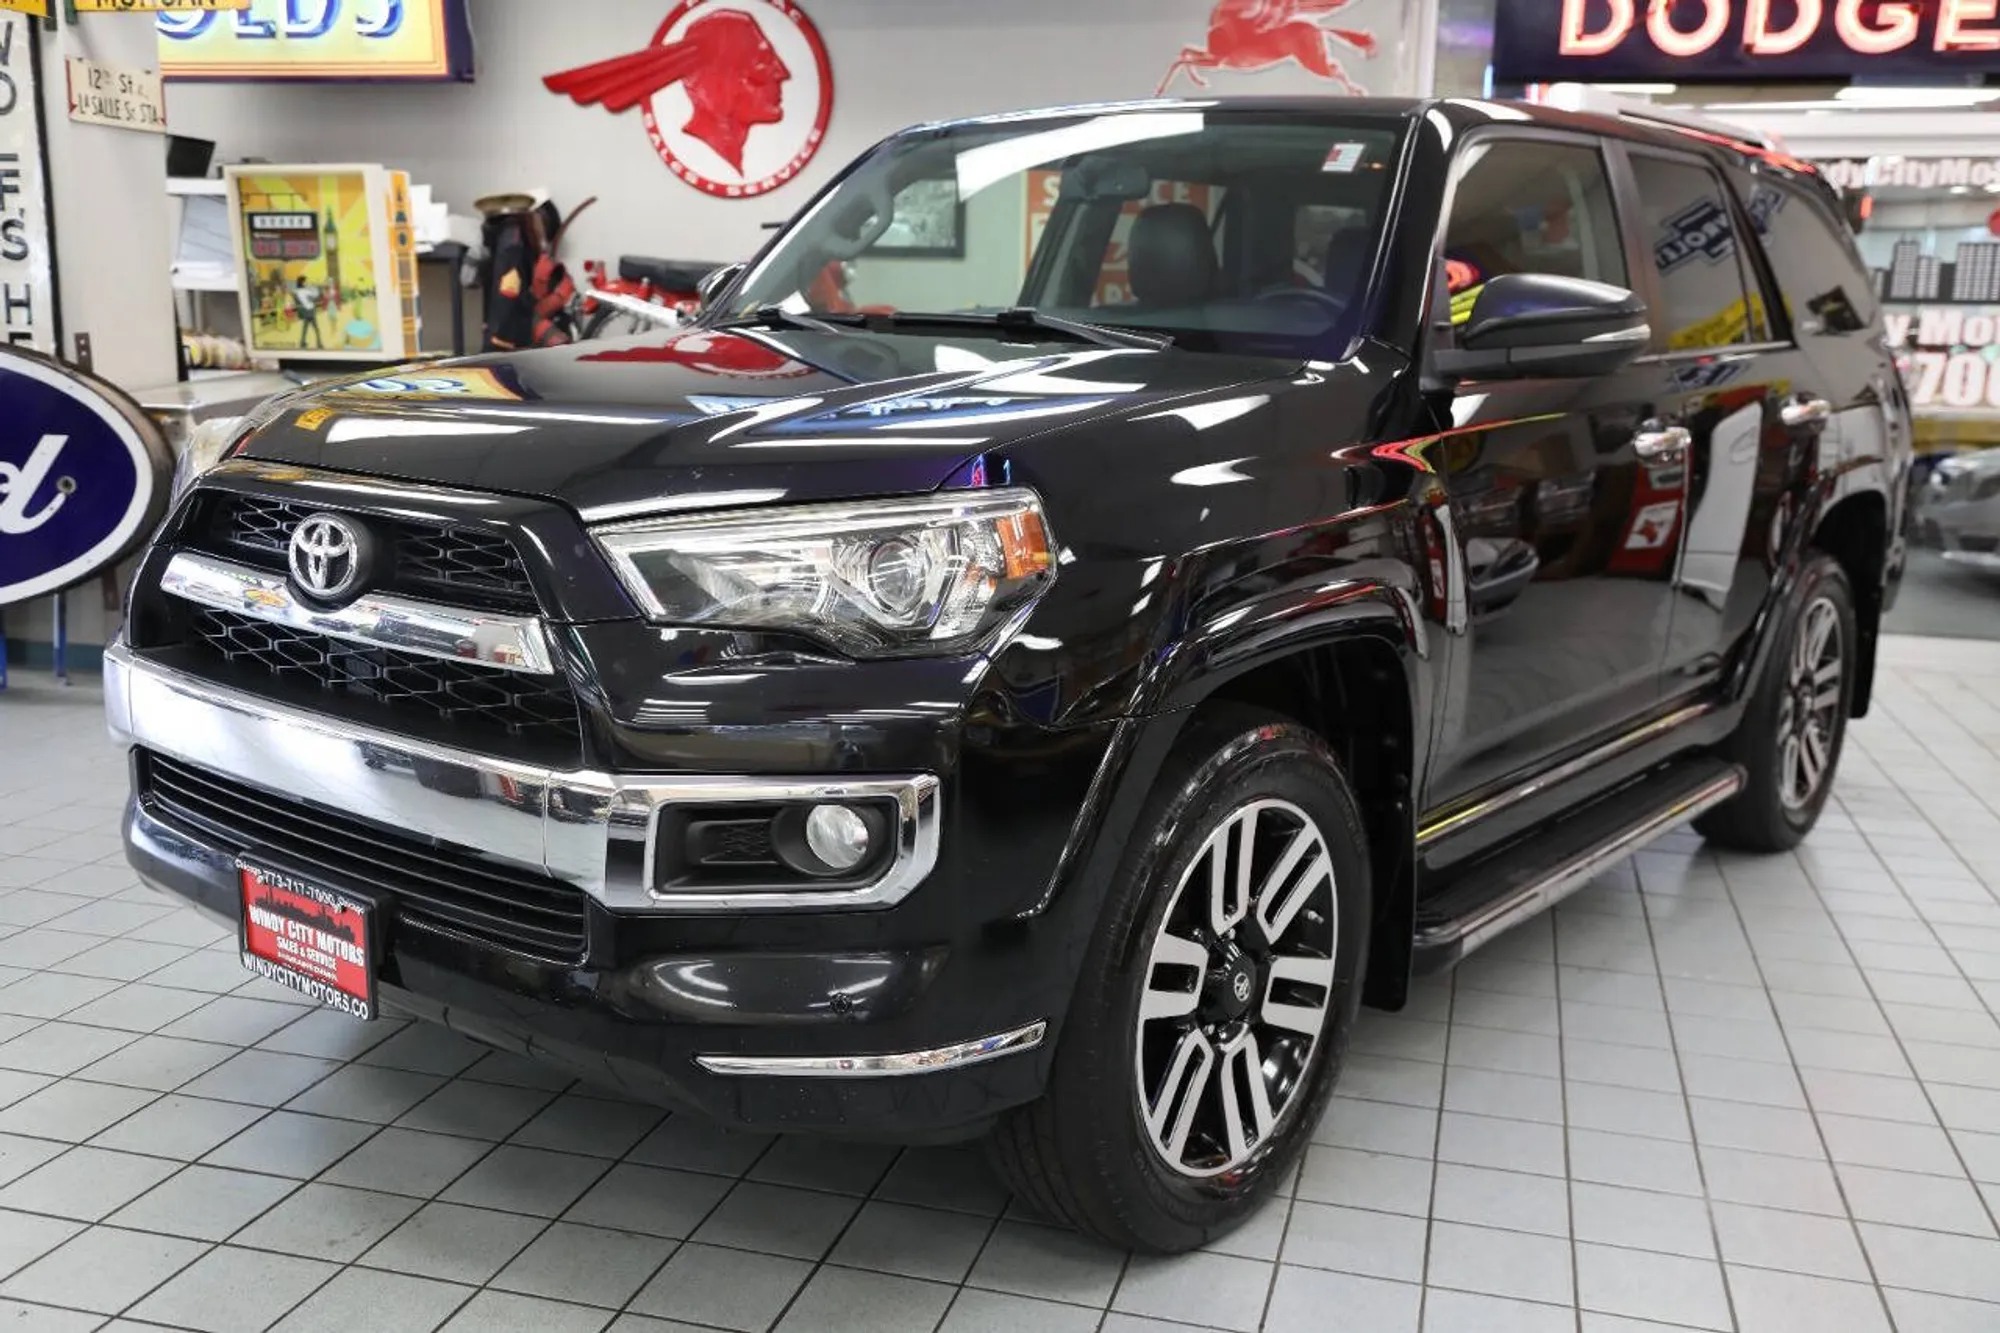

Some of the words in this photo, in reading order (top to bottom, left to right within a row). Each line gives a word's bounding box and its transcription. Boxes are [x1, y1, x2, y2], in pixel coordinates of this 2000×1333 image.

[1558, 0, 2000, 56] DODGE
[249, 903, 287, 934] WINDY
[288, 919, 314, 946] CITY
[315, 930, 364, 966] MOTORS
